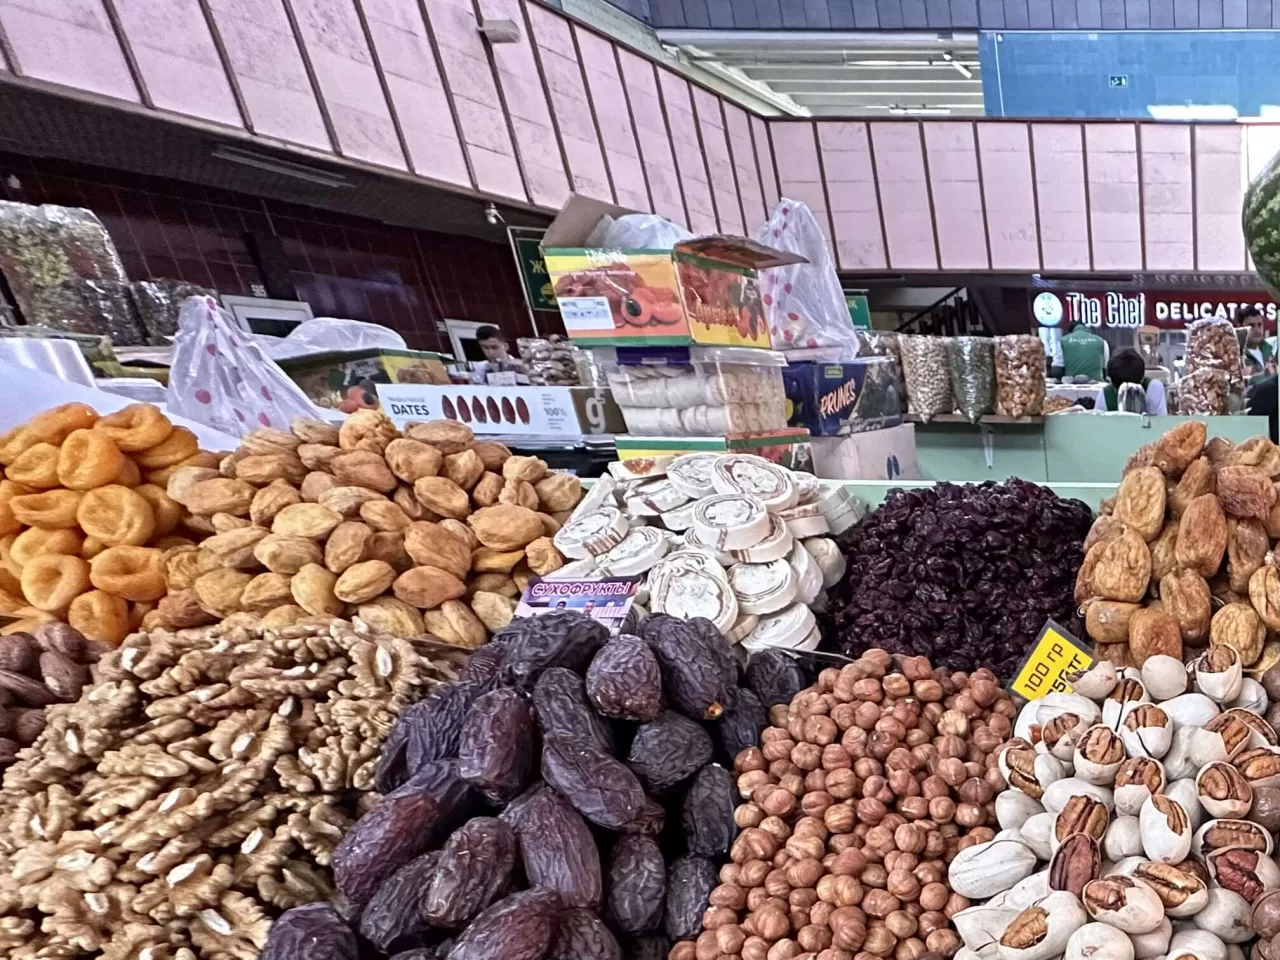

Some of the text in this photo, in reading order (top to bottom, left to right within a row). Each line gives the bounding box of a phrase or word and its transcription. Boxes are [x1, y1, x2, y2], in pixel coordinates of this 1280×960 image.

[1066, 292, 1145, 328] The Chef
[391, 404, 430, 416] DATES
[820, 379, 856, 419] PRUNES
[532, 582, 631, 596] СУХОФРУКТЫ
[1024, 643, 1063, 692] 100 гр
